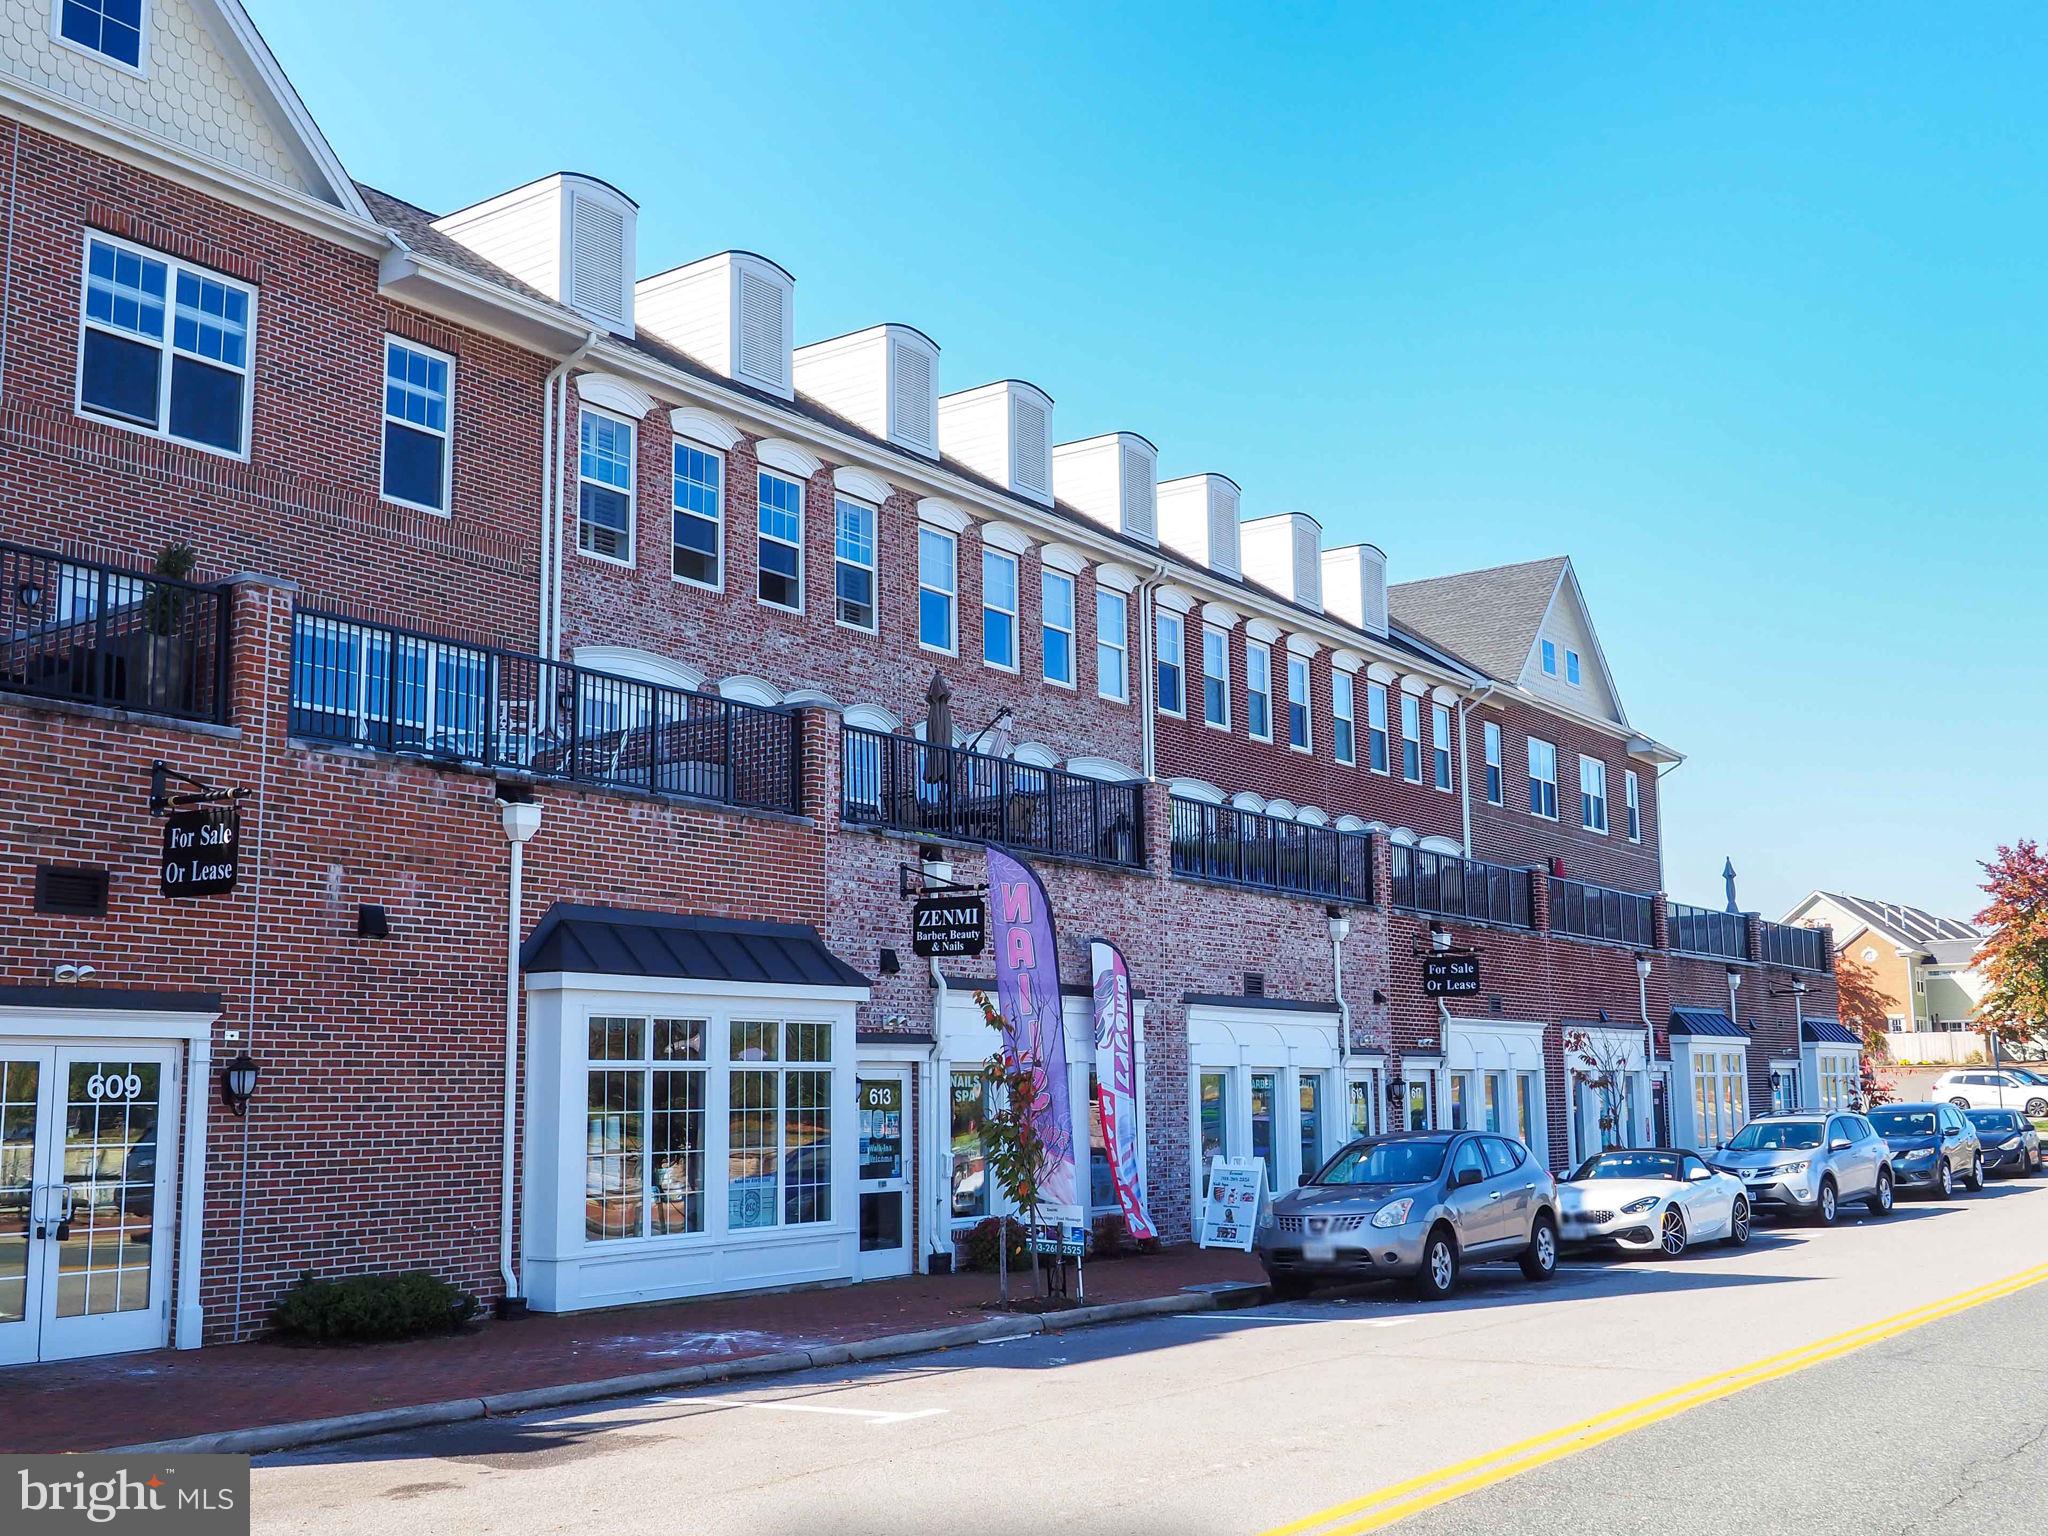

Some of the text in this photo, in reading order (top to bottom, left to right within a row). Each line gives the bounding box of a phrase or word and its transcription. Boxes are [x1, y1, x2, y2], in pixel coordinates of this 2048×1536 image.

[170, 823, 232, 849] For Sale
[165, 860, 233, 884] Or Lease
[918, 908, 979, 927] ZENMI
[916, 930, 980, 941] Barber, Beauty
[931, 941, 964, 952] & Nails
[1429, 963, 1474, 974] For Sale
[1427, 979, 1476, 991] Or Lease
[87, 1074, 142, 1099] 609
[950, 1075, 980, 1088] NAILS
[1252, 1079, 1274, 1089] ARBER
[1299, 1079, 1318, 1089] EAUTY
[869, 1088, 892, 1105] 613
[955, 1089, 977, 1103] SPA
